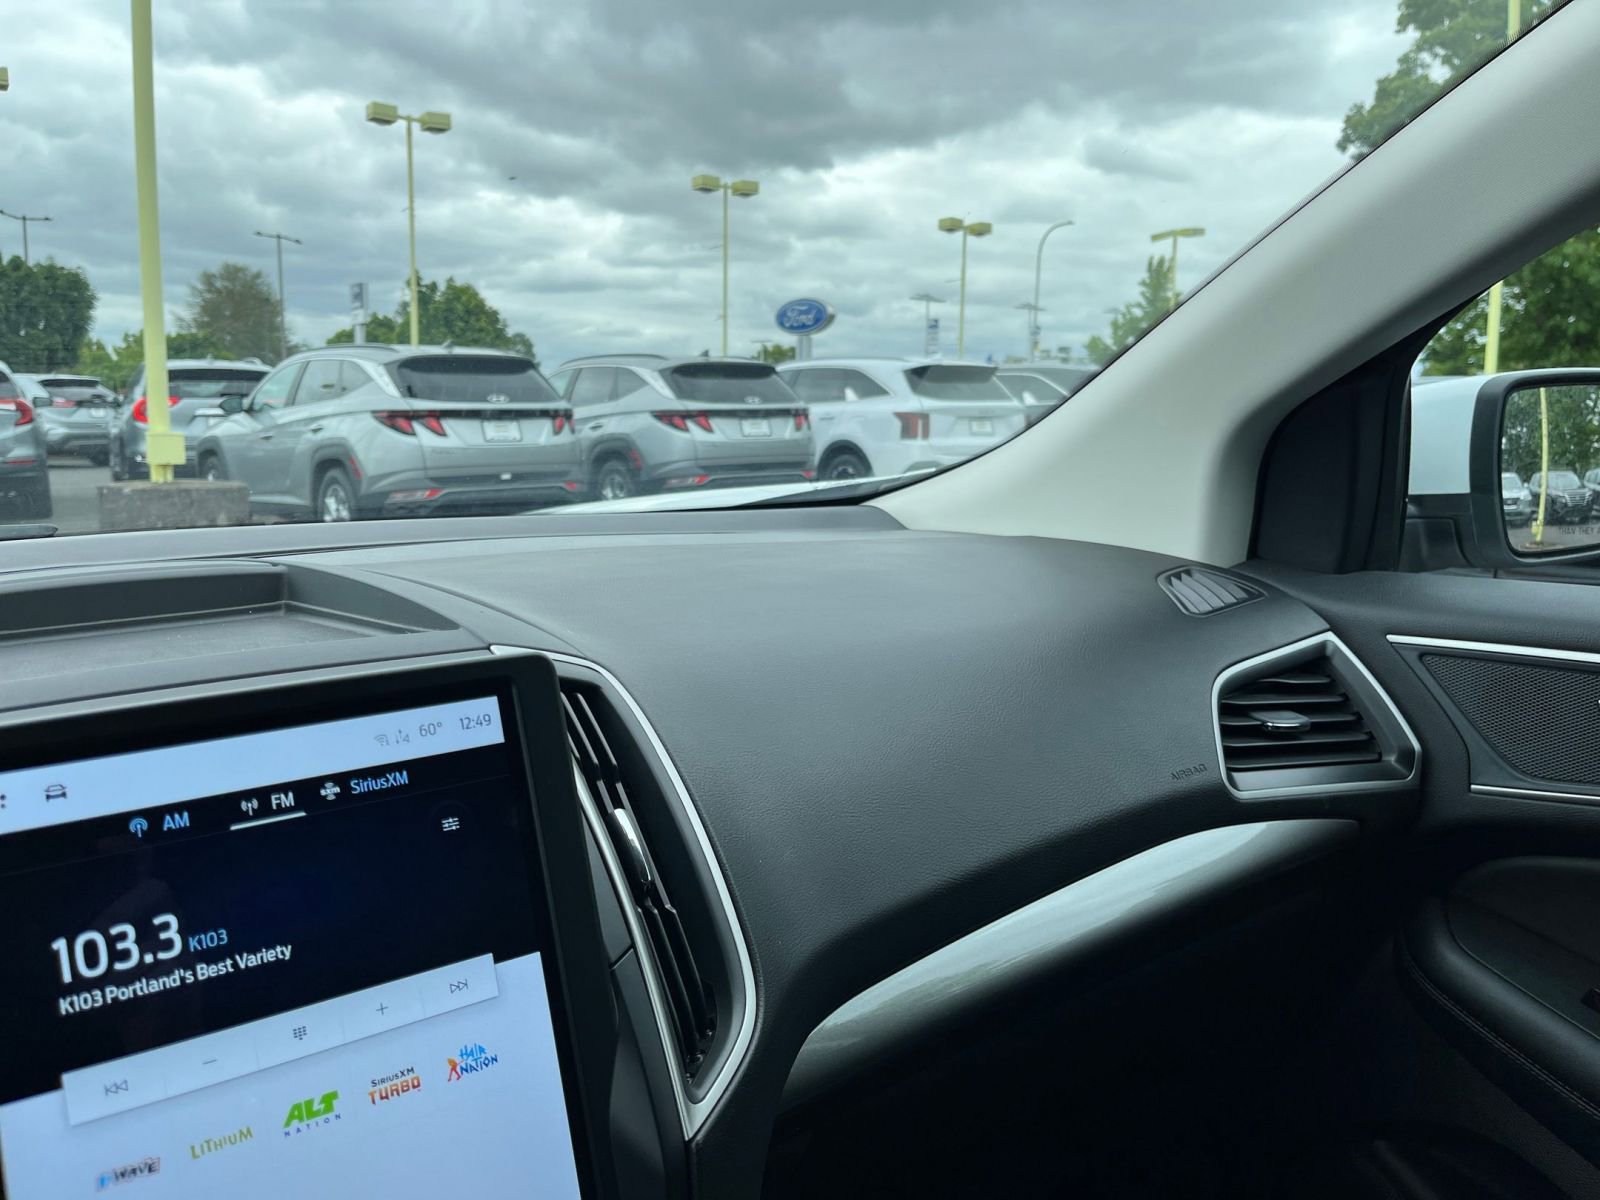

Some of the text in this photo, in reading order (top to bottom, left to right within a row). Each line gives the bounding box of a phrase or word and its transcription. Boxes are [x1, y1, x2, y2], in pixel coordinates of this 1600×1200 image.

[783, 305, 817, 328] Ford
[418, 713, 492, 737] 60° 12:49
[350, 770, 410, 794] SiriusXM
[1170, 763, 1208, 781] AIRBAG
[270, 792, 295, 810] FM
[162, 811, 191, 831] AM
[50, 912, 229, 985] 103.3 K103
[58, 944, 293, 1016] K103 Portland's Best Variety
[458, 1042, 488, 1061] HAIR
[459, 1054, 498, 1076] NATION
[368, 1075, 422, 1105] TURBO
[282, 1089, 341, 1129] ALT
[284, 1112, 342, 1137] NATION
